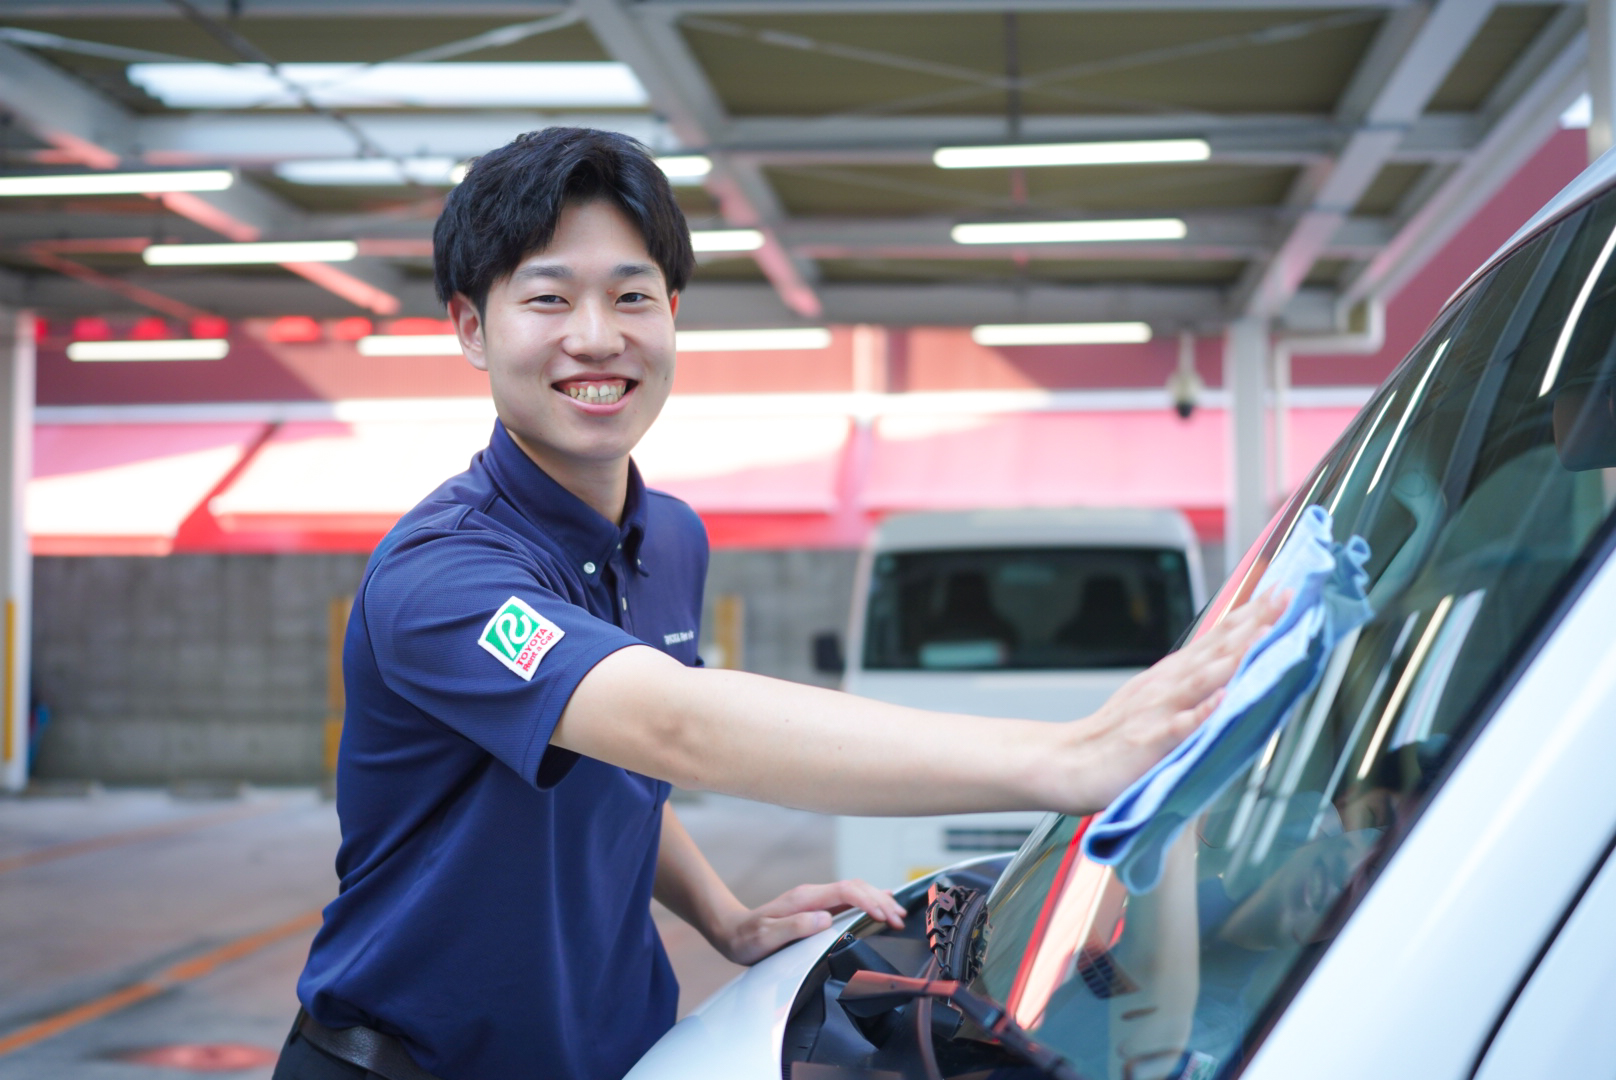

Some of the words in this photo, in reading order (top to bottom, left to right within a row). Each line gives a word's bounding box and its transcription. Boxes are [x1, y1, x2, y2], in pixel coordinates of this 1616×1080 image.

[516, 628, 548, 666] TOYOTA
[522, 652, 539, 672] Rent
[540, 632, 555, 646] Car
